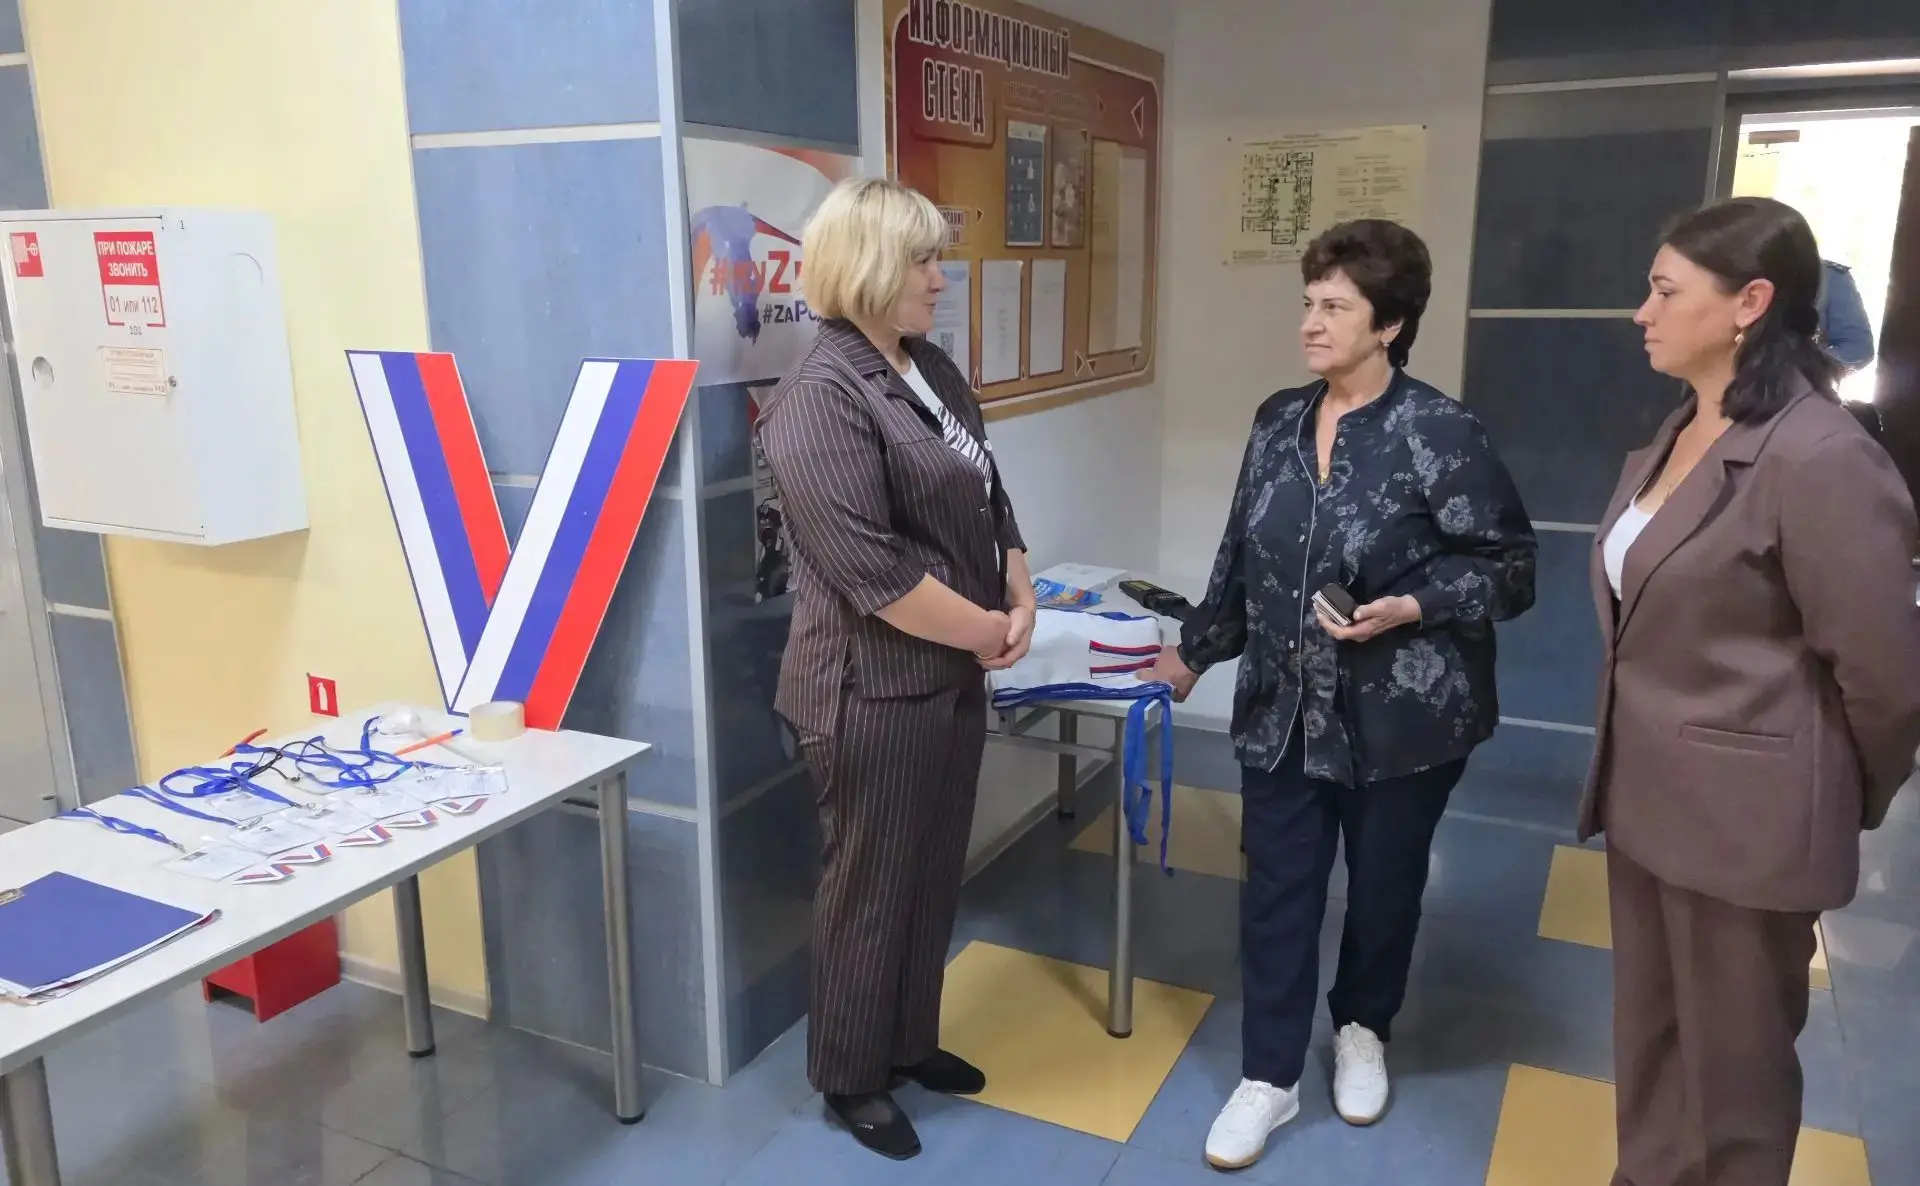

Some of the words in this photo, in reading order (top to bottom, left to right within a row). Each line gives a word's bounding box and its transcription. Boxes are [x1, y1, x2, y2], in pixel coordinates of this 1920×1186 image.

[908, 0, 1070, 80] ИНФОРМАЦИОННЫЙ
[922, 57, 986, 136] СТЕНД
[97, 240, 117, 256] ПРИ
[116, 240, 154, 256] ПОЖАРЕ
[107, 261, 149, 277] ЗВОНИТЬ
[109, 295, 121, 313] 01
[141, 295, 159, 314] 112
